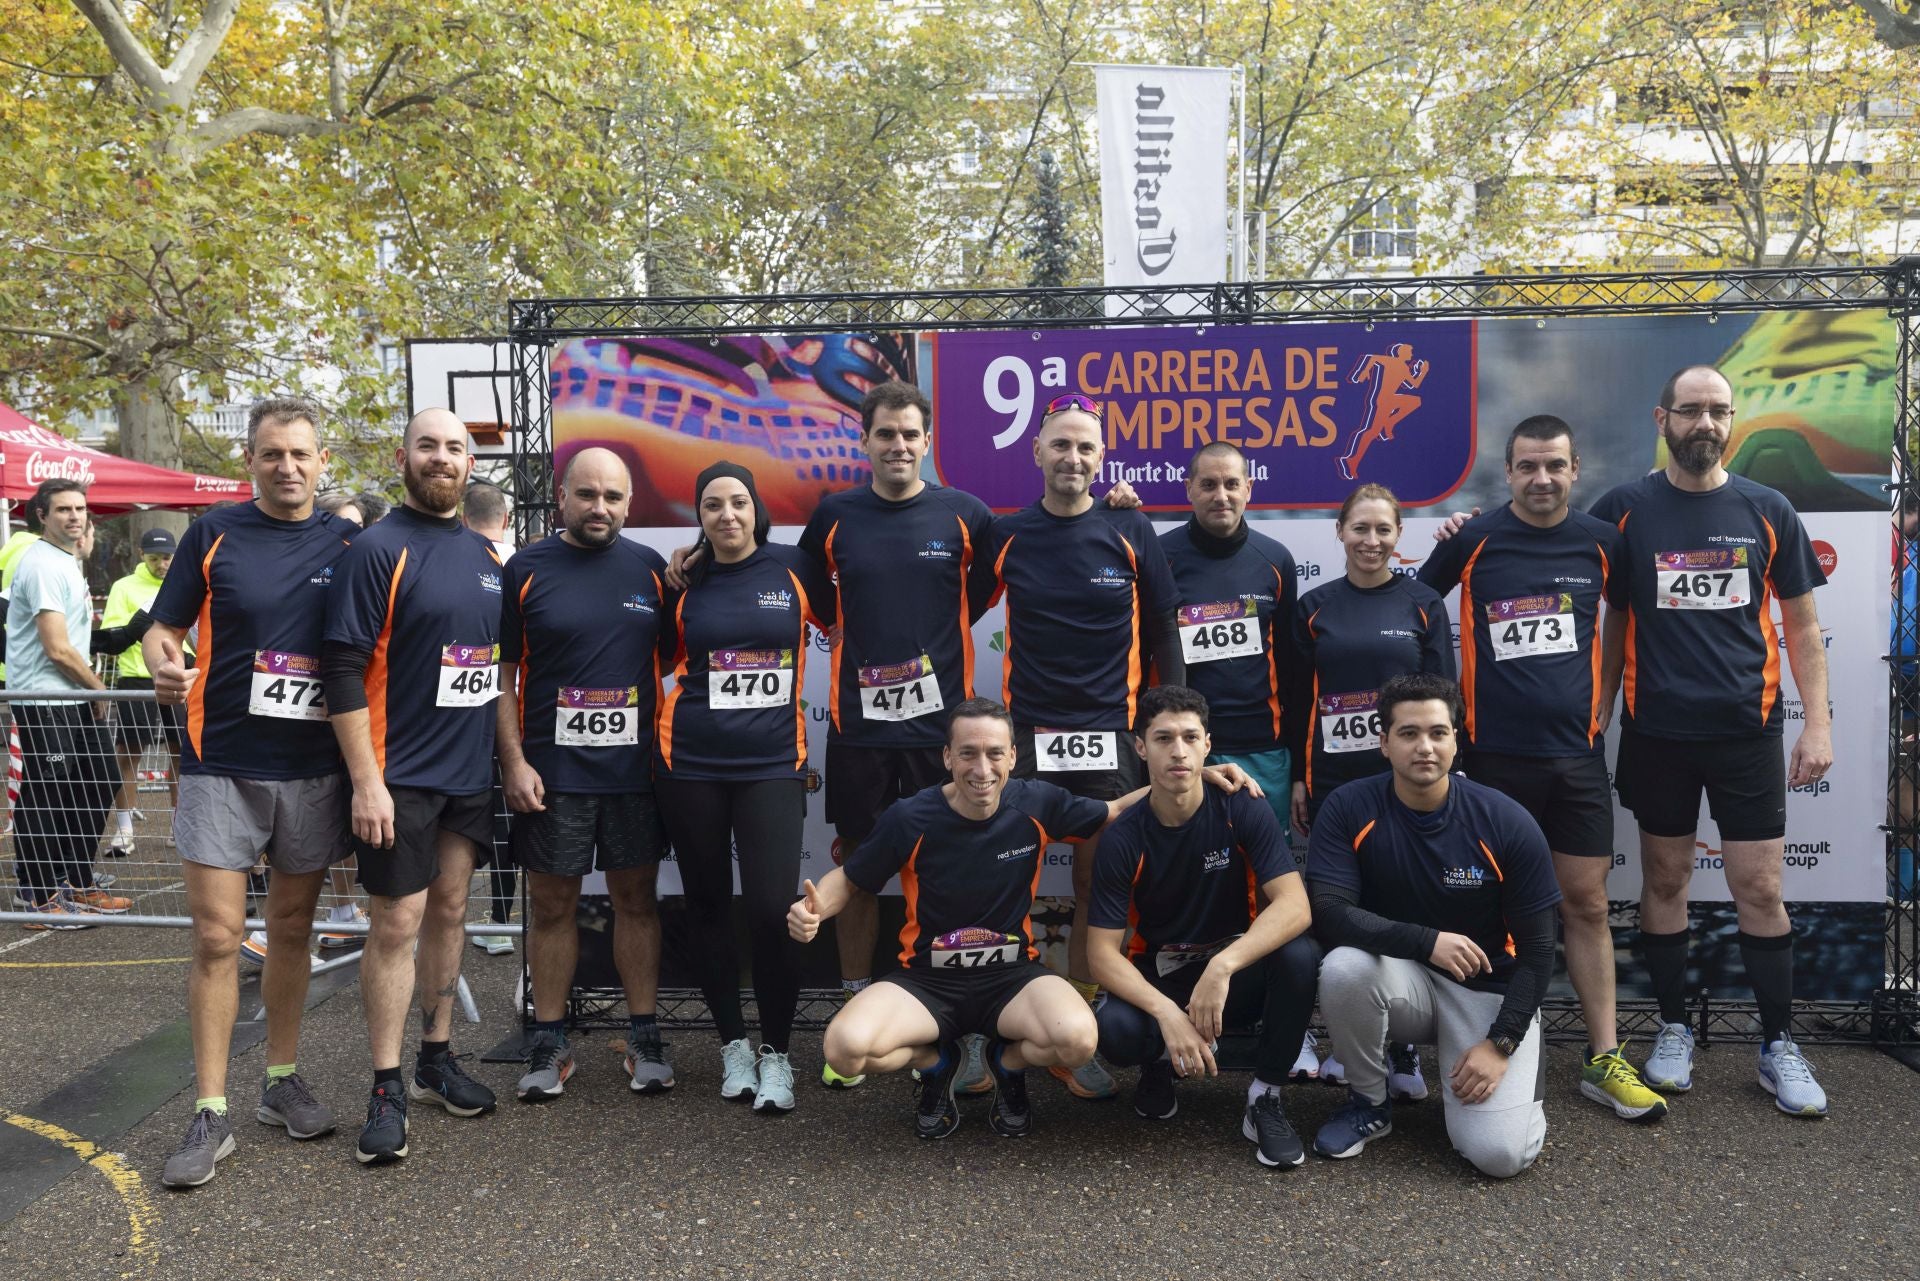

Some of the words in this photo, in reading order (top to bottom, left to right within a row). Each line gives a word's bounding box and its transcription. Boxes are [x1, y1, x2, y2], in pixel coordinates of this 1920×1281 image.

[1077, 348, 1272, 395] CARRERA
[1285, 346, 1338, 391] DE
[1107, 460, 1163, 484] Norte
[1164, 461, 1187, 483] de
[1670, 572, 1733, 598] 467
[1513, 598, 1536, 606] CARRERA
[1514, 602, 1546, 612] EMPRESAS
[1192, 622, 1248, 650] 468
[1502, 618, 1562, 646] 473
[287, 662, 320, 672] EMPRESAS
[288, 655, 314, 664] CARRERA
[736, 656, 766, 664] EMPRESAS
[450, 668, 492, 694] 464
[720, 672, 780, 696] 470
[264, 678, 325, 708] 472
[872, 682, 924, 710] 471
[566, 712, 626, 734] 469
[1332, 713, 1382, 740] 466
[1047, 734, 1104, 758] 465
[998, 852, 1009, 860] red
[1206, 853, 1220, 862] red
[1783, 842, 1831, 854] enault
[1443, 876, 1482, 886] itevelesa
[1450, 870, 1465, 878] red
[1468, 866, 1484, 880] itv
[960, 928, 984, 937] CARRERA
[960, 934, 992, 942] EMPRESAS
[944, 948, 1005, 968] 474
